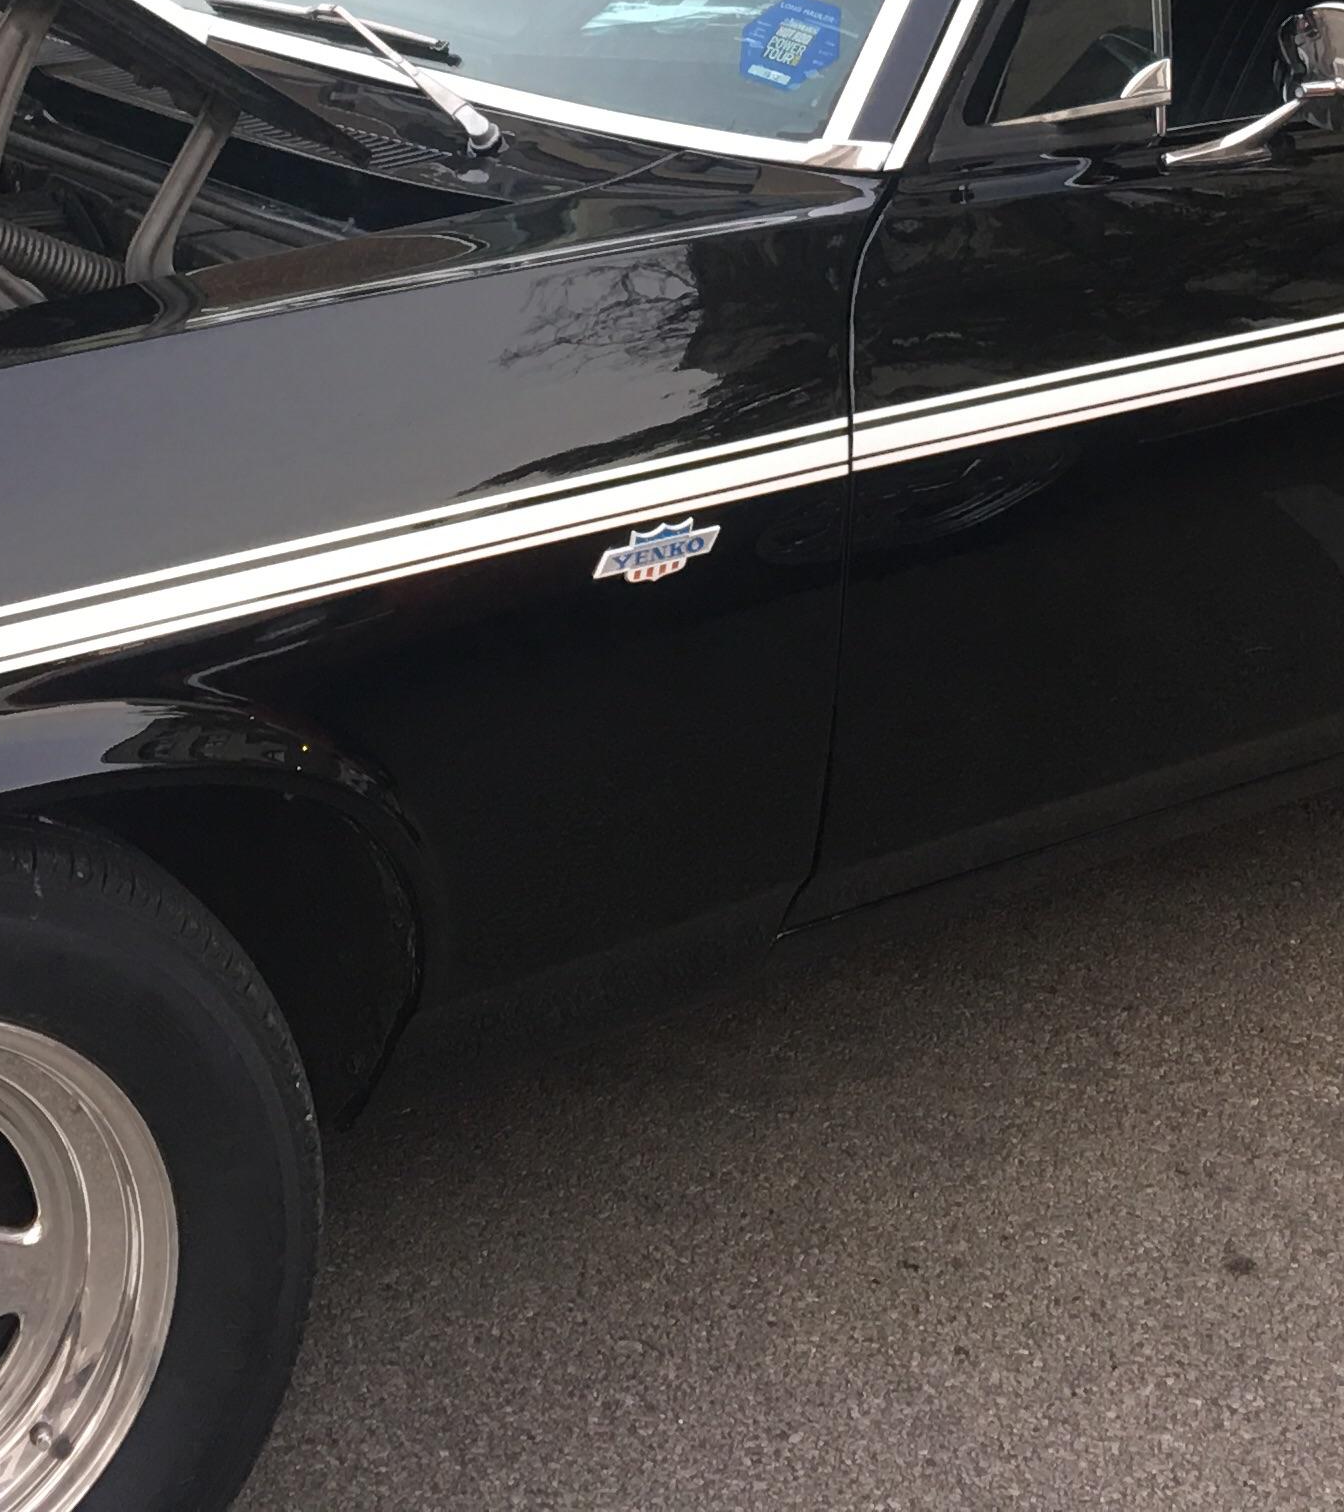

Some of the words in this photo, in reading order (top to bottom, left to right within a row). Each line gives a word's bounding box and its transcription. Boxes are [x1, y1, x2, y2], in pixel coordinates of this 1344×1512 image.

[763, 46, 794, 65] TOUR
[766, 36, 807, 56] POWER
[612, 536, 705, 569] YENKO
